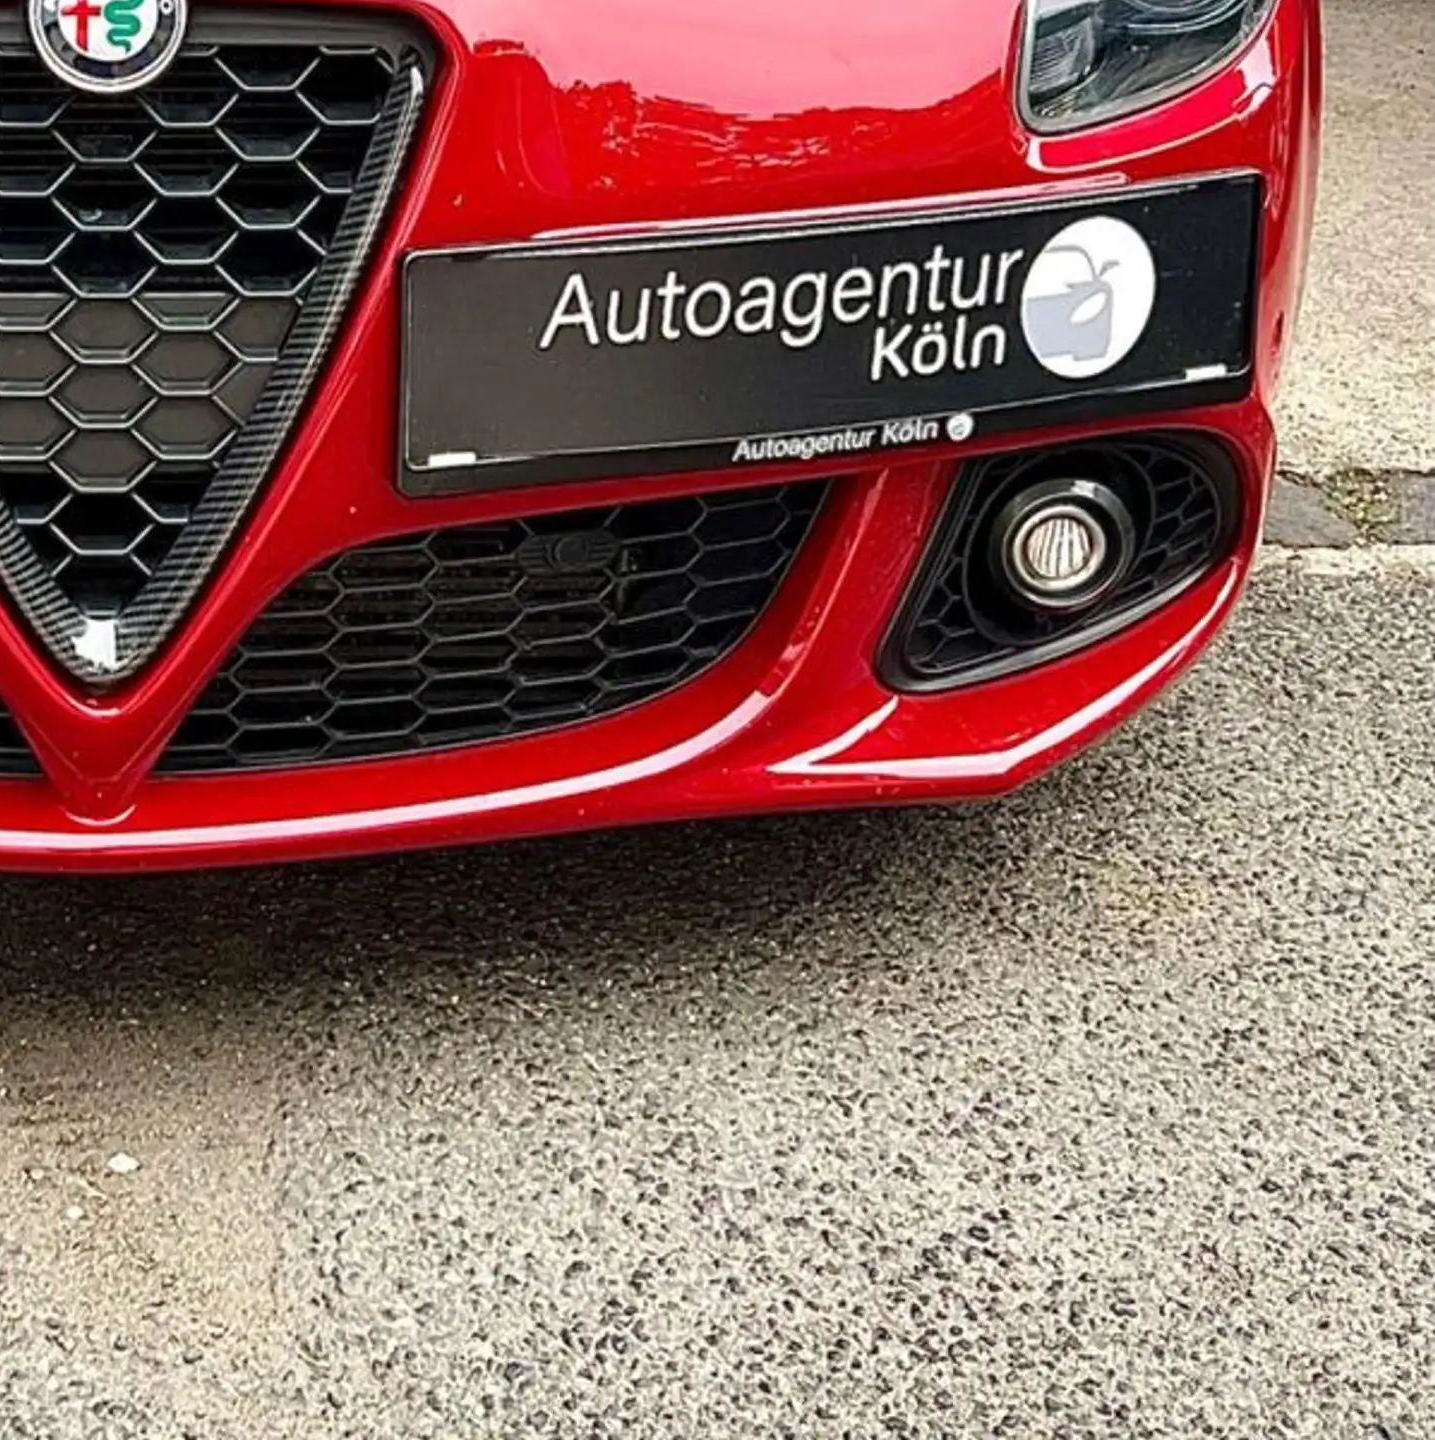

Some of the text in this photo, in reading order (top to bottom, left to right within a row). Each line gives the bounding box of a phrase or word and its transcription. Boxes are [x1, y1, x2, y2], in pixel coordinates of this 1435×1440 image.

[539, 244, 1024, 352] Autoagentur
[870, 316, 1007, 382] Köln
[732, 417, 939, 462] Autoagentur Köln
